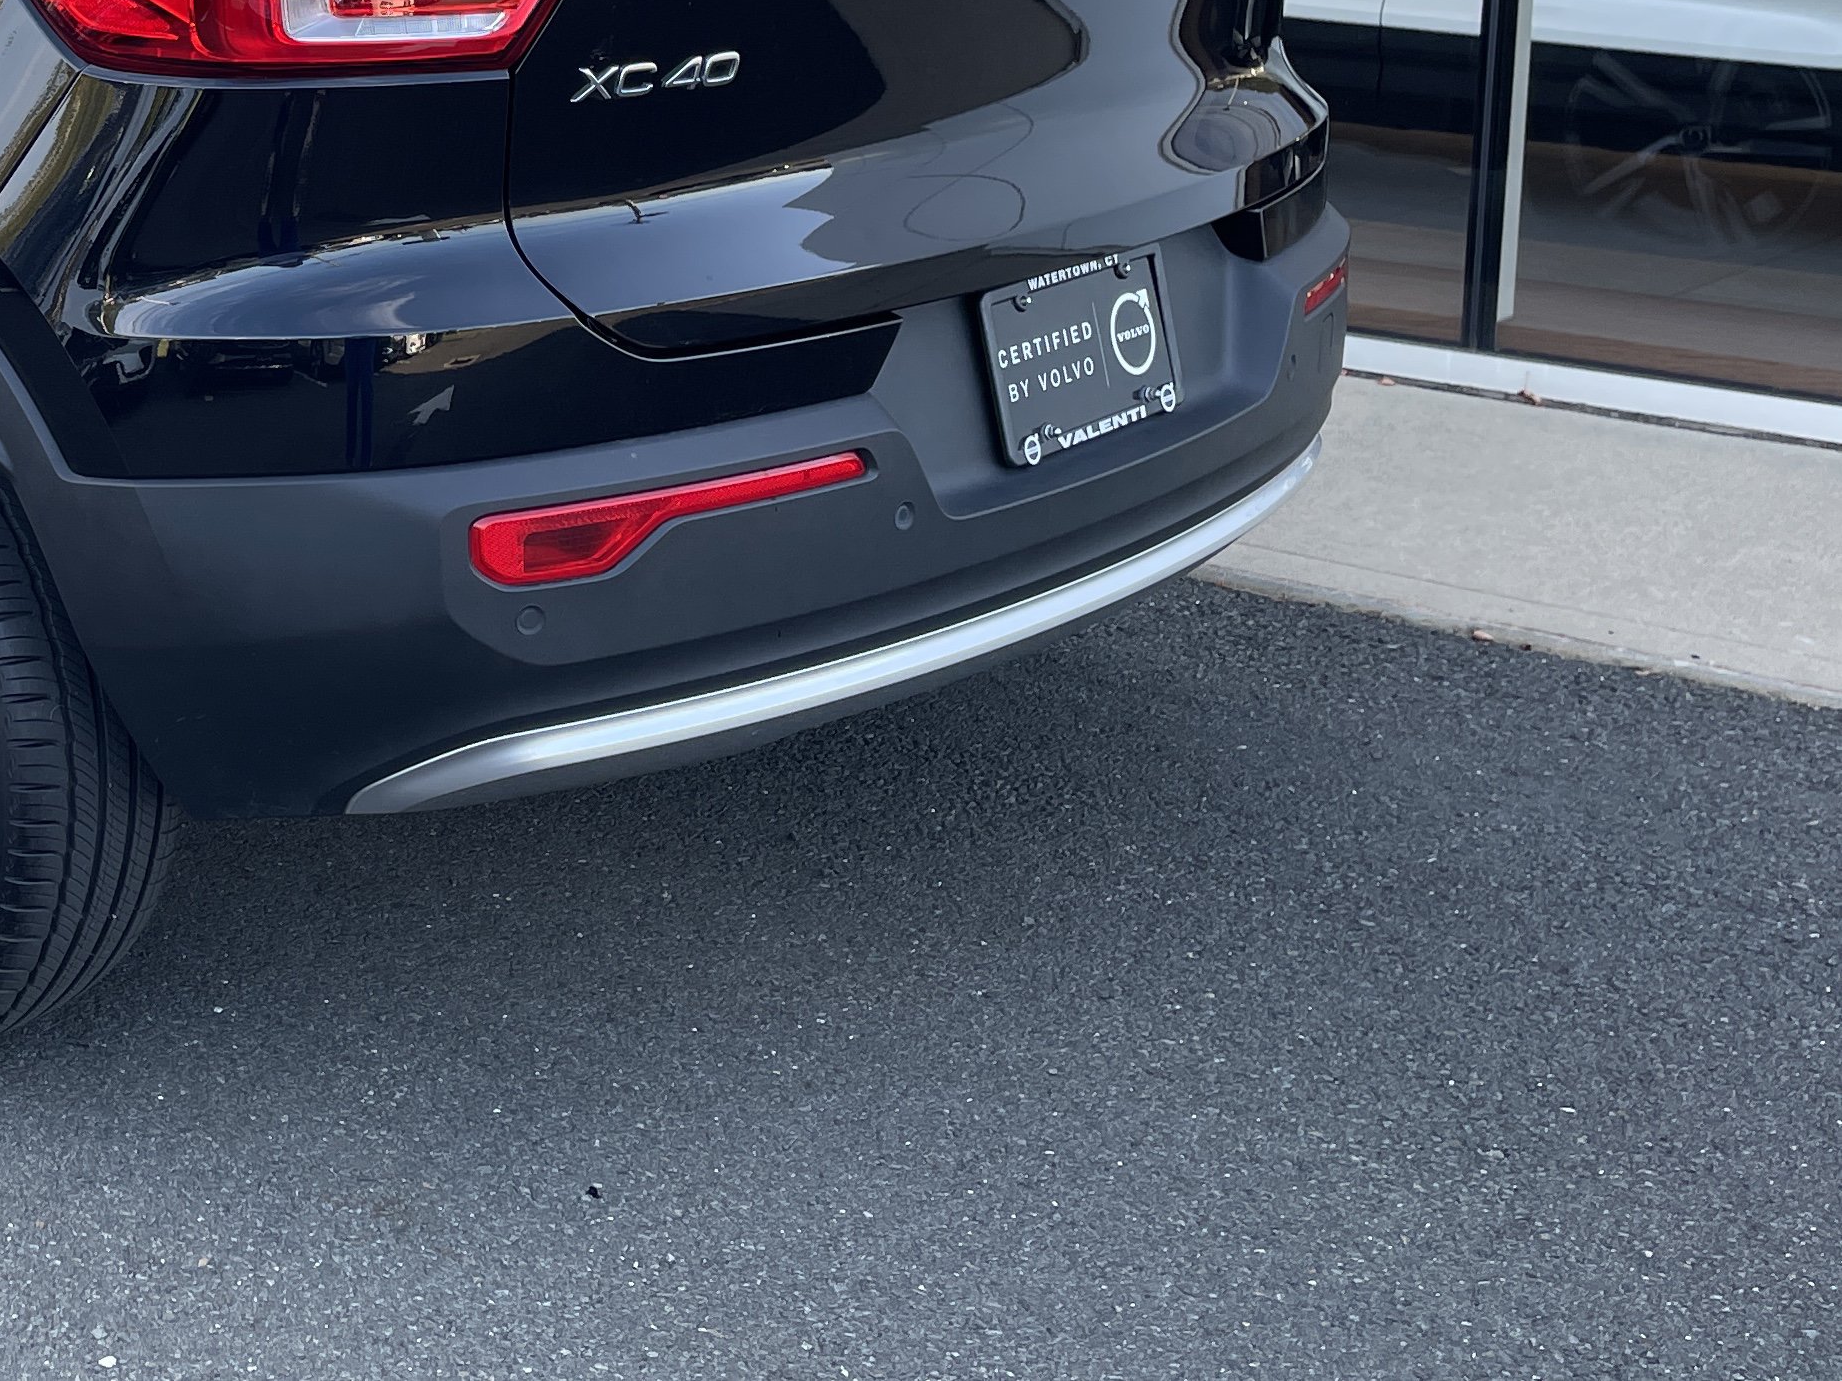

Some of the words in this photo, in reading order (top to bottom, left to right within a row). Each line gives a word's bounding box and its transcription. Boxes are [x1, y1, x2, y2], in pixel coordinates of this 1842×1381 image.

[1105, 254, 1119, 267] CT
[997, 321, 1093, 369] CERTIFIED
[1116, 324, 1150, 343] VOLVO
[1008, 378, 1030, 403] BY
[1038, 357, 1095, 392] VOLVO
[1058, 405, 1147, 449] VALENTI
